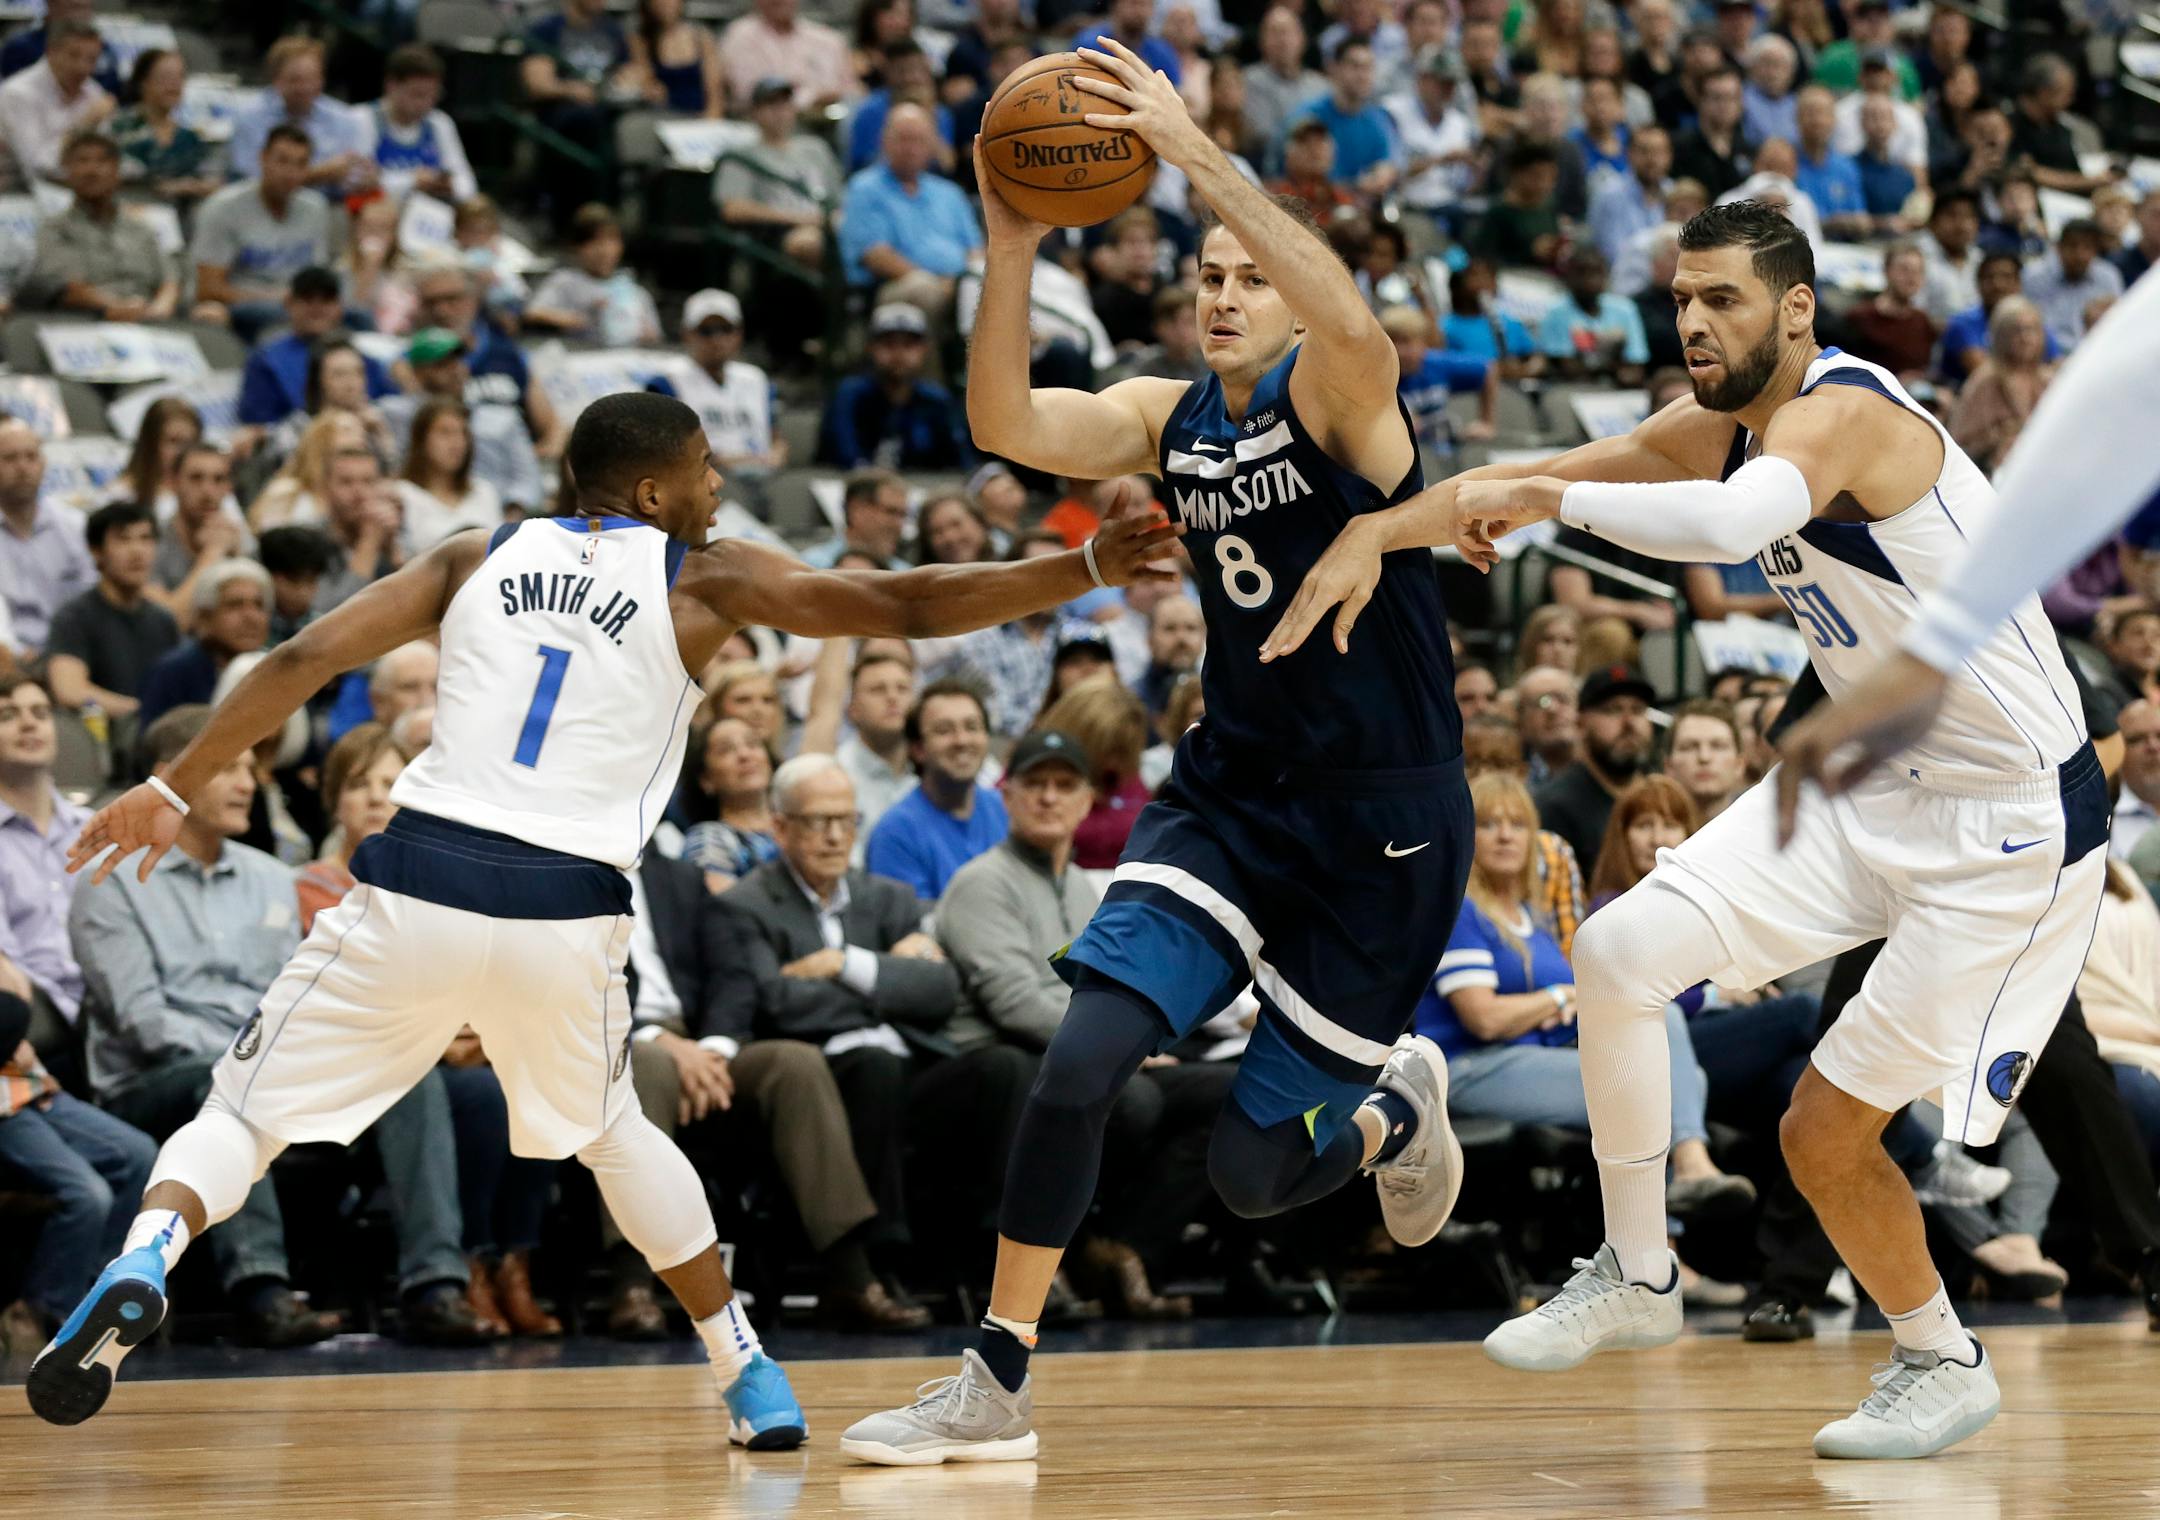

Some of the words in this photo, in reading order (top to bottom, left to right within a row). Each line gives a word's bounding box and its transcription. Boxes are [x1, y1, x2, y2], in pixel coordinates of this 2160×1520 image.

[1013, 133, 1132, 169] SPALDING
[1214, 534, 1274, 609] 8
[499, 572, 595, 616] SMITH
[590, 590, 639, 646] JR.
[1774, 580, 1858, 648] 50
[512, 643, 573, 770] 1
